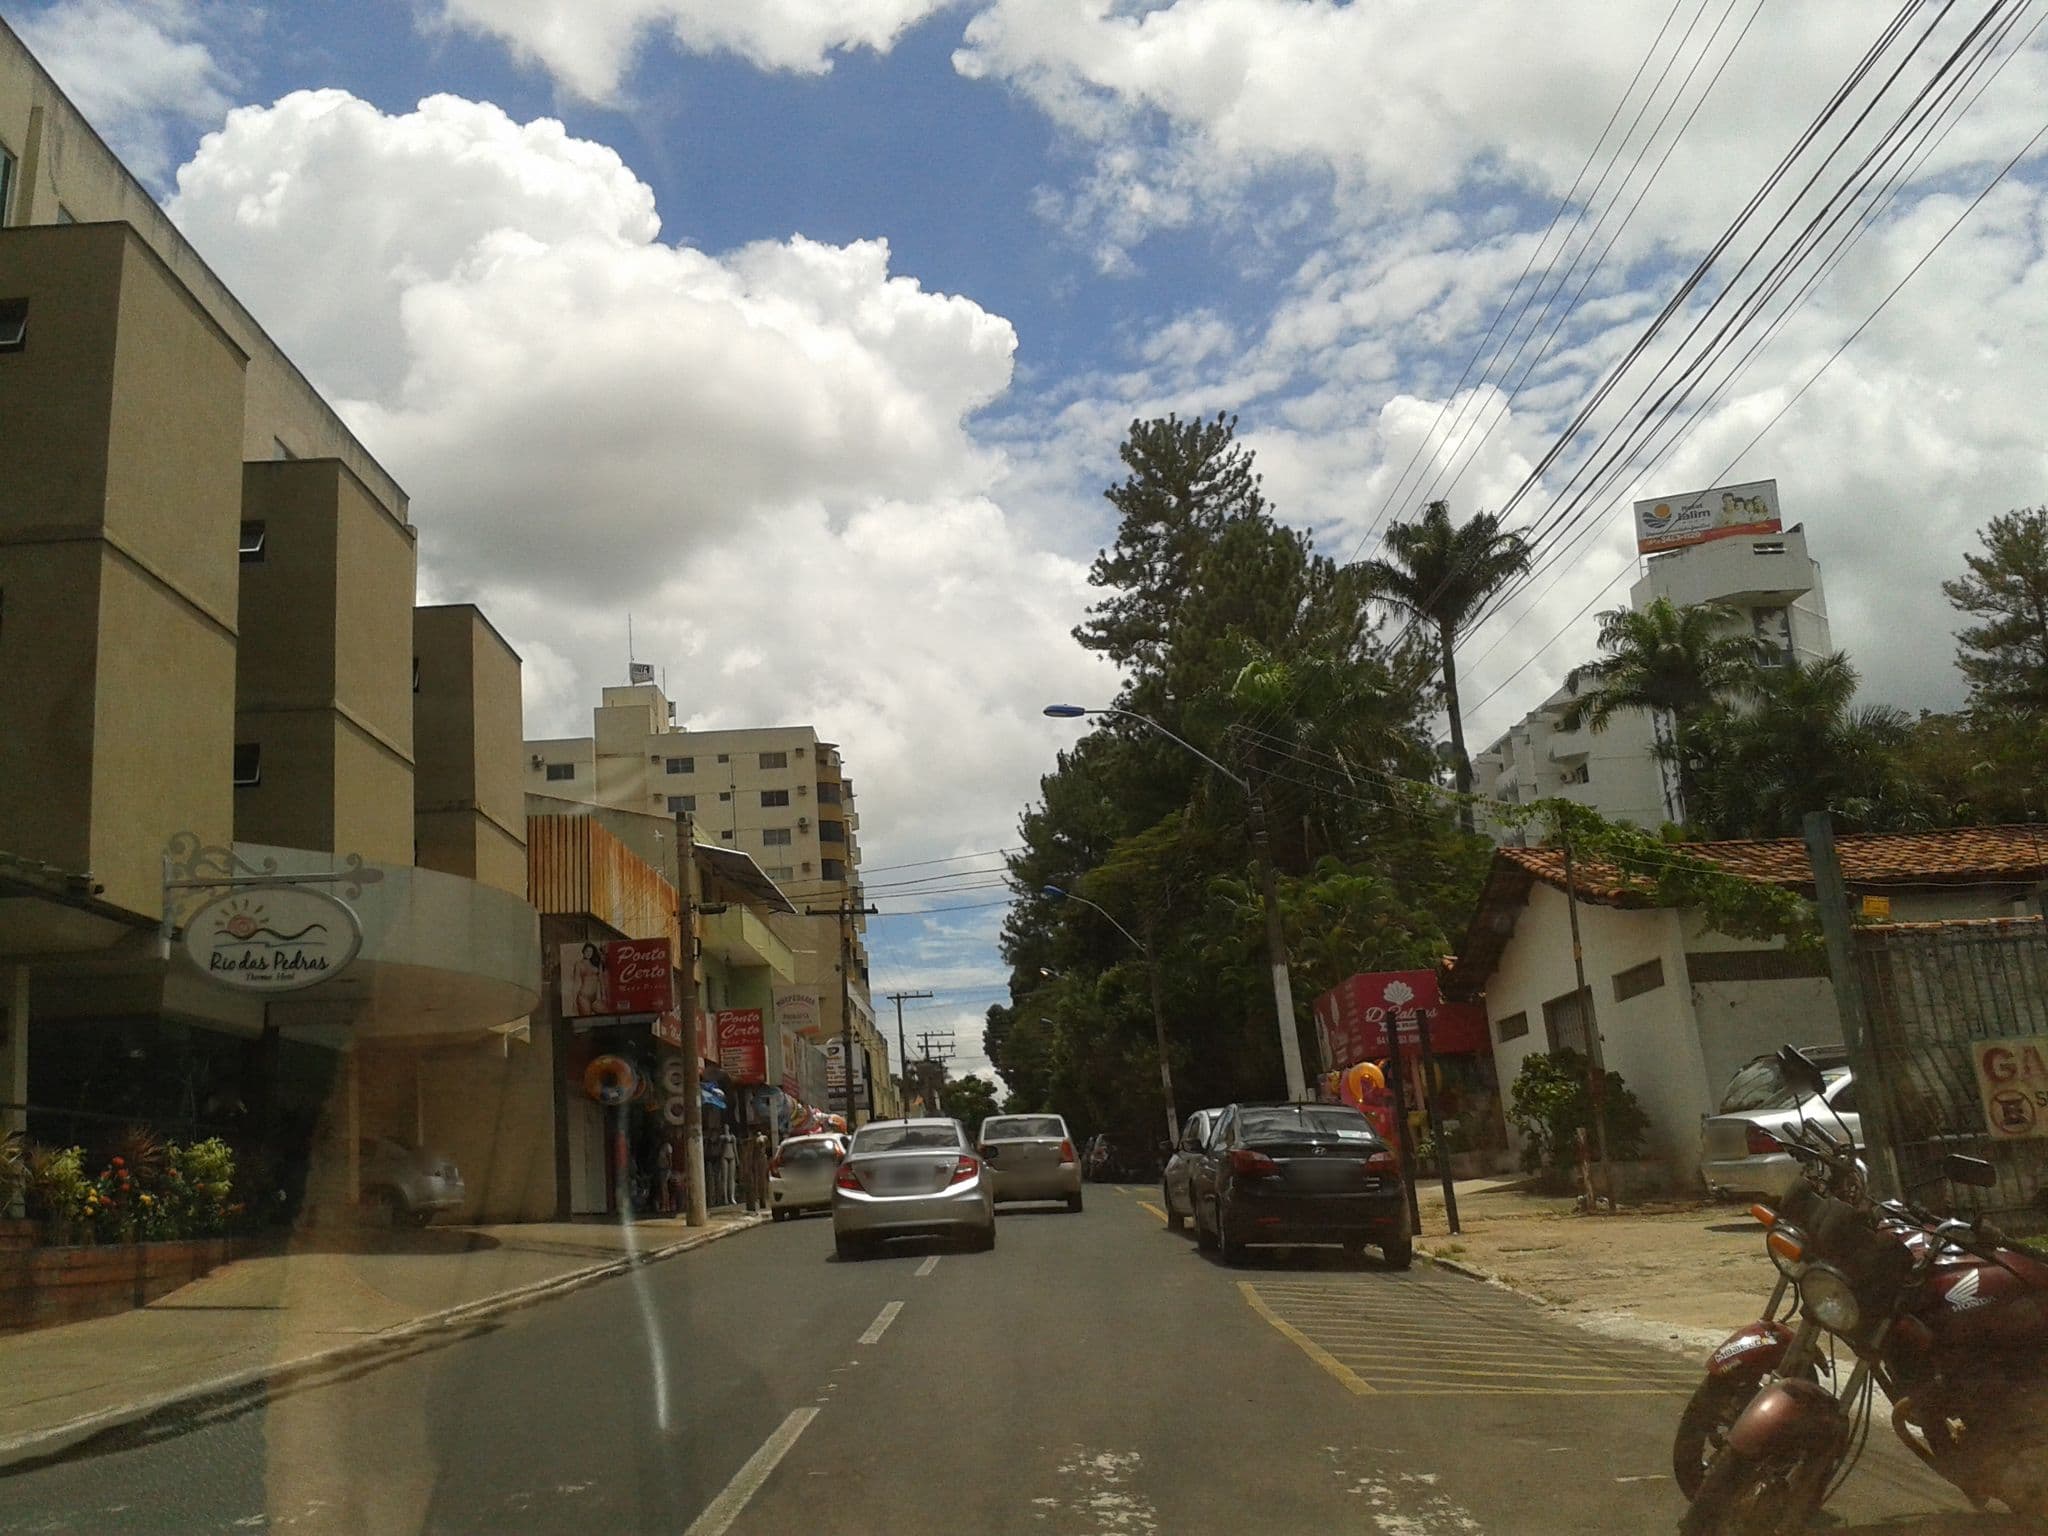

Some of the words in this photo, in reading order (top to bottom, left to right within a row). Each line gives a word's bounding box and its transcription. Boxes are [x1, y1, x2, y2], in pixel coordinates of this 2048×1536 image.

[238, 950, 270, 970] das
[273, 950, 330, 970] Pedras
[617, 946, 665, 964] Ponto
[620, 963, 665, 983] Certo
[719, 1011, 760, 1025] Ponto
[721, 1024, 760, 1040] Certo
